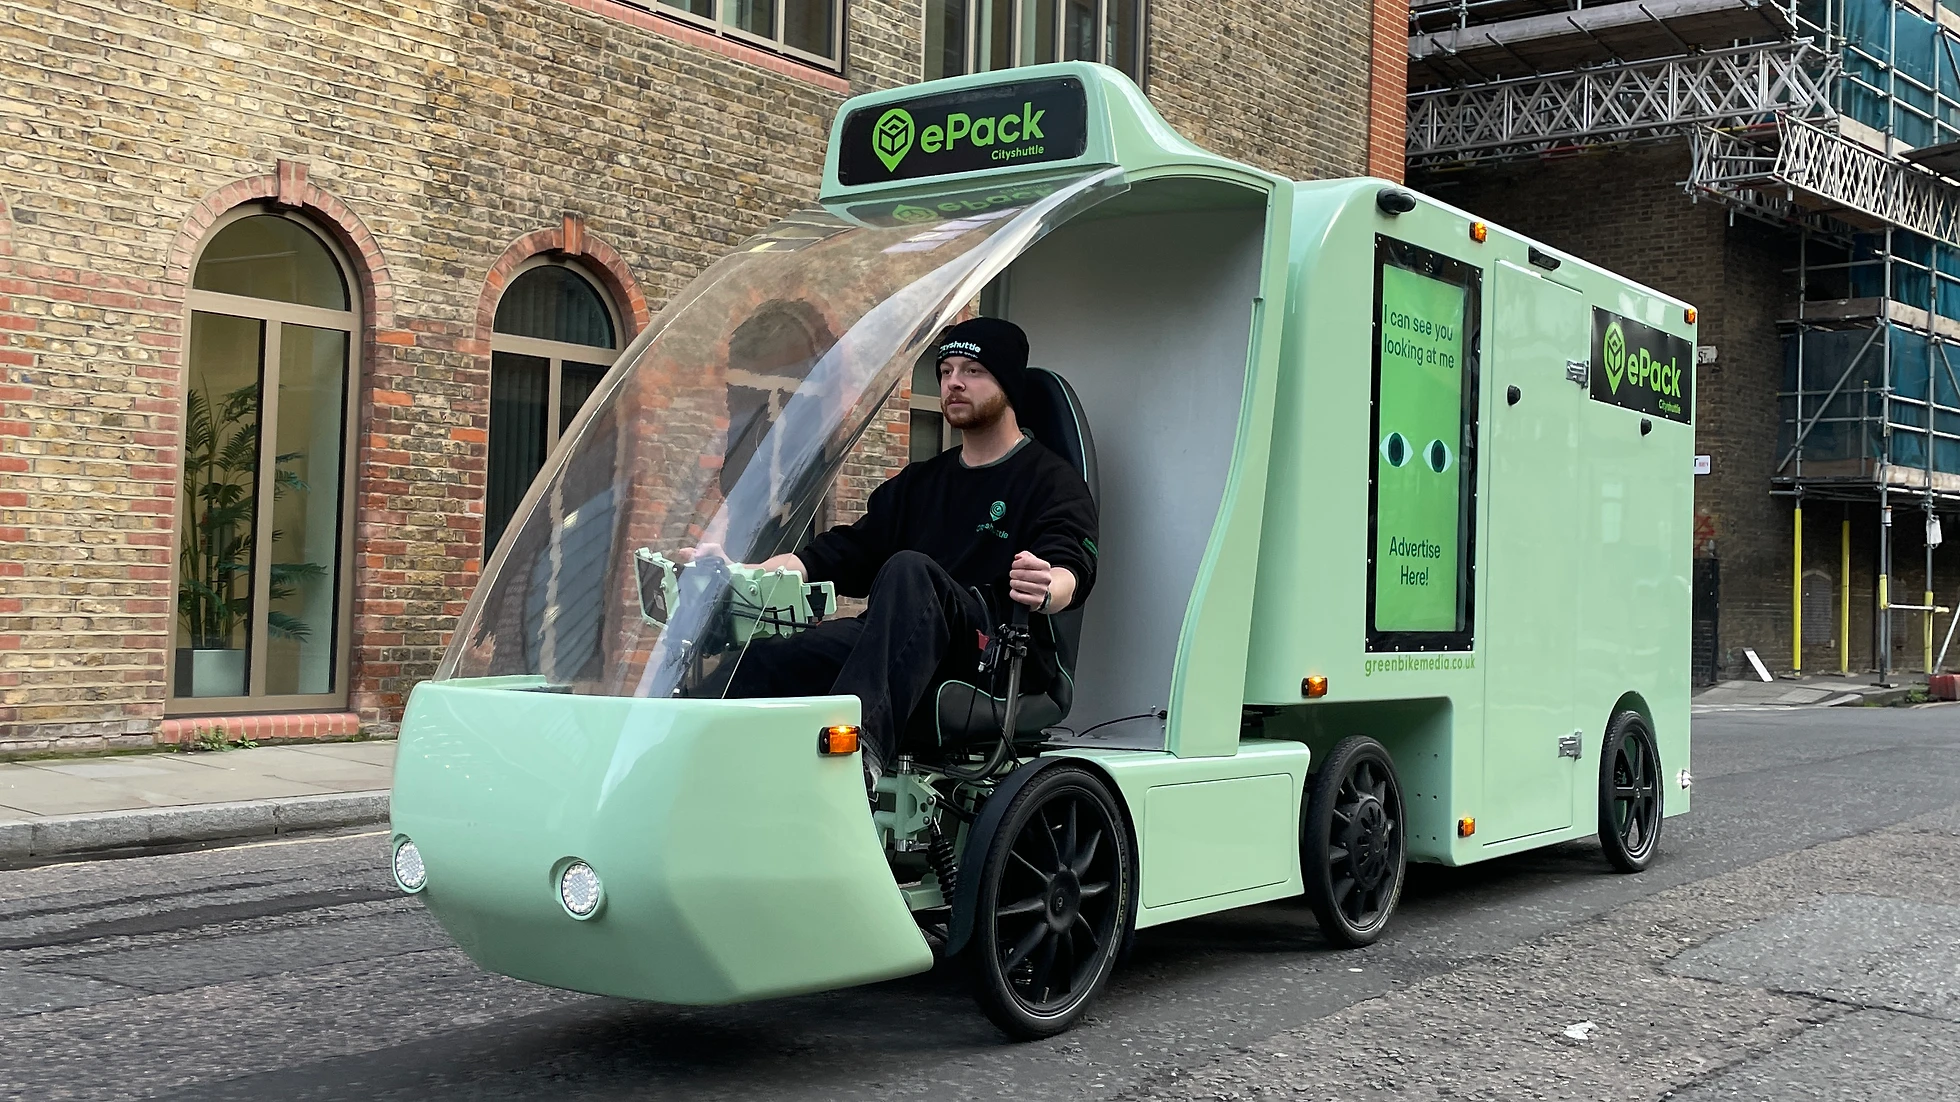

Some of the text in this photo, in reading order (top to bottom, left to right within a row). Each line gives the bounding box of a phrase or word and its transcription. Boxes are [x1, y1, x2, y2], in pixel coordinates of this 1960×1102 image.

[920, 101, 1046, 153] ePack
[991, 144, 1044, 161] Cityshuttle
[1384, 304, 1453, 342] I can see you
[1384, 333, 1455, 369] looking at me
[1627, 347, 1682, 398] ePack
[1389, 536, 1441, 559] Advertise
[1400, 565, 1429, 586] Here!
[1364, 654, 1476, 677] greenbikemedia.co.uk
